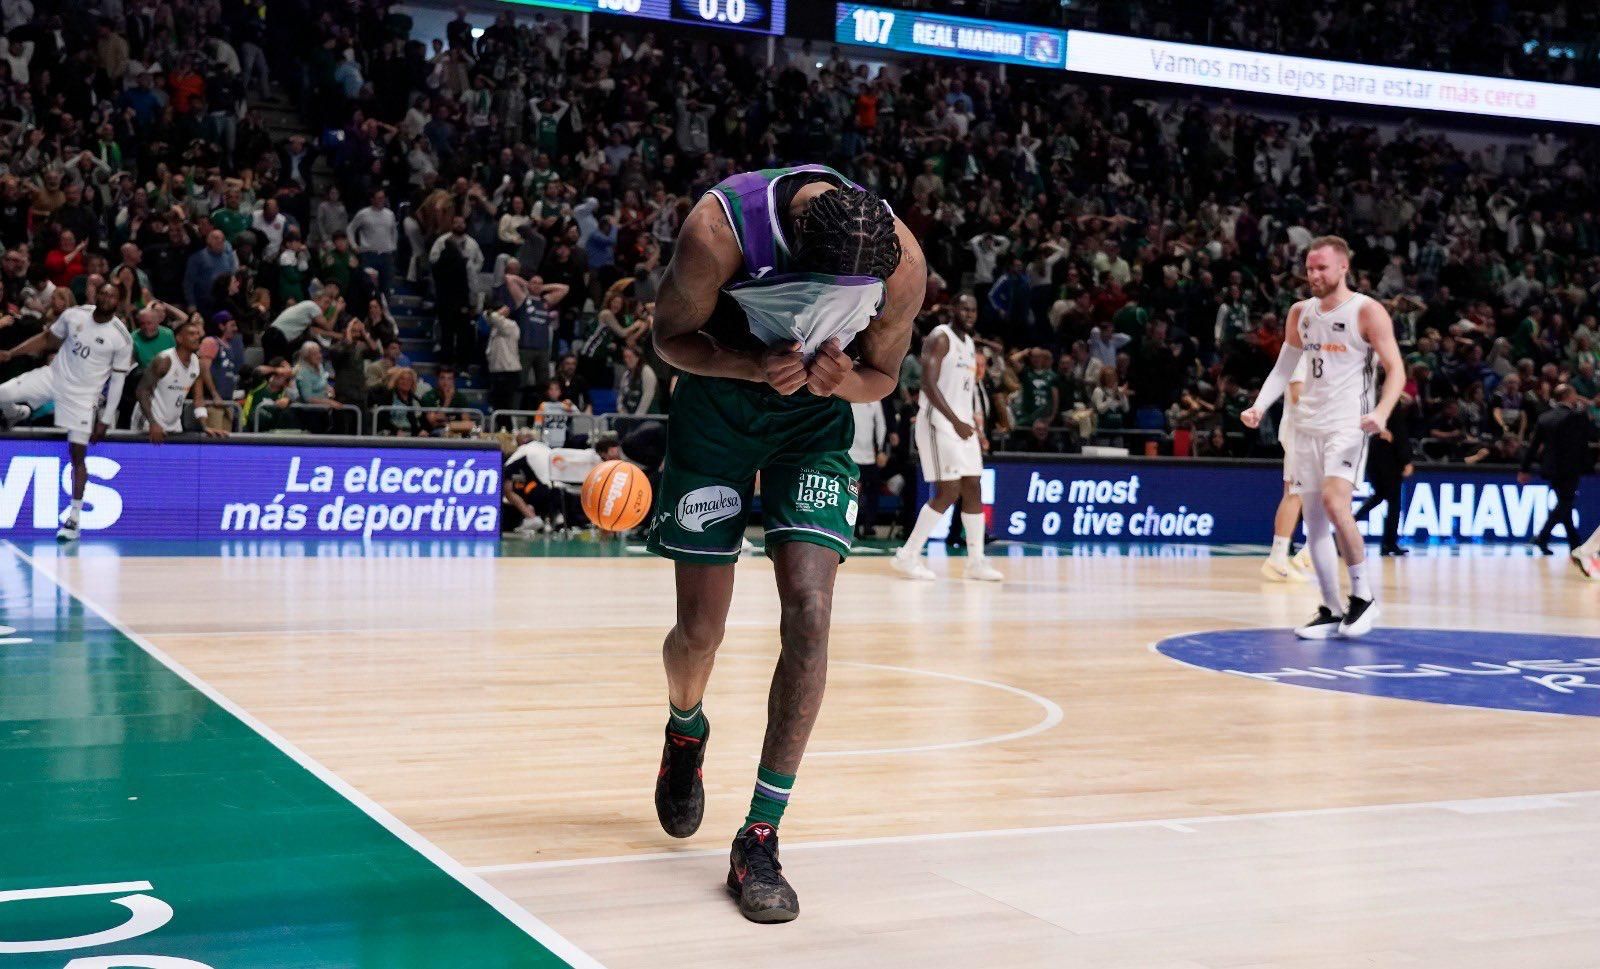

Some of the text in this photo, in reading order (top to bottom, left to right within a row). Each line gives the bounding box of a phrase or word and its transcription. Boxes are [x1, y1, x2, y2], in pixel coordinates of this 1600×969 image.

[852, 8, 895, 45] 107
[912, 22, 1023, 56] REAL MADRID
[1150, 48, 1537, 109] Vamos más lejos para estar más cerca
[71, 341, 91, 359] 20
[1312, 357, 1324, 378] 13
[285, 456, 499, 494] La elección
[805, 474, 840, 494] má
[1068, 474, 1140, 504] most
[679, 489, 740, 522] famadesa
[797, 482, 839, 509] laga
[220, 493, 498, 537] más deportiva
[1129, 505, 1215, 536] choice
